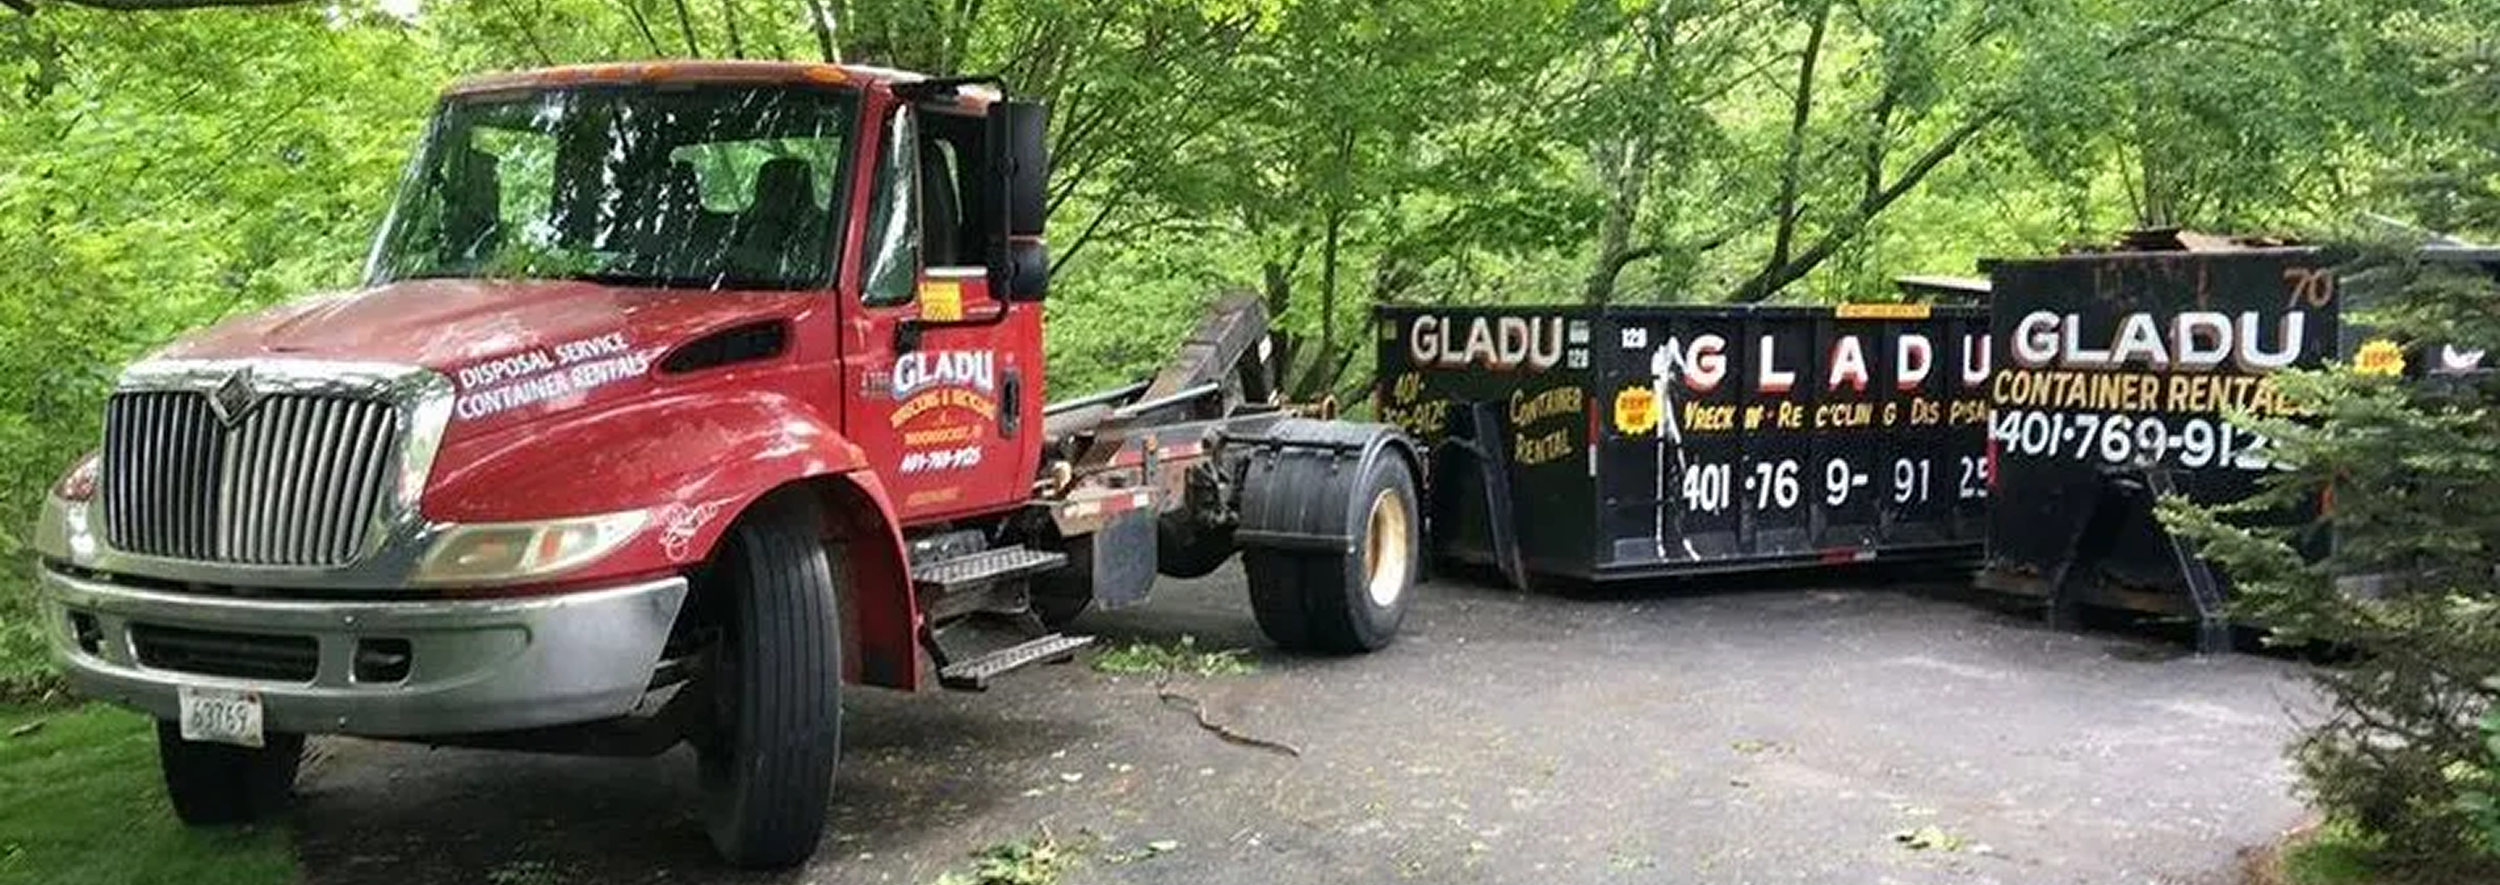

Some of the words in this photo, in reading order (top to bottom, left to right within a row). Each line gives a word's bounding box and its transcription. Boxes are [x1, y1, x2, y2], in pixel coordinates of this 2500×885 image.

[2284, 268, 2332, 307] 70
[459, 348, 556, 389] DISPOSAL
[555, 331, 629, 365] SERVICE
[1411, 315, 1564, 371] GLADU
[1682, 333, 1992, 393] GLADU
[2011, 310, 2305, 369] GLADU
[457, 371, 569, 420] CONTAINER
[570, 350, 649, 389] RENTALS
[892, 350, 995, 400] GLADU
[1993, 369, 2161, 412] CONTAINER
[2167, 374, 2312, 416] RENTAL
